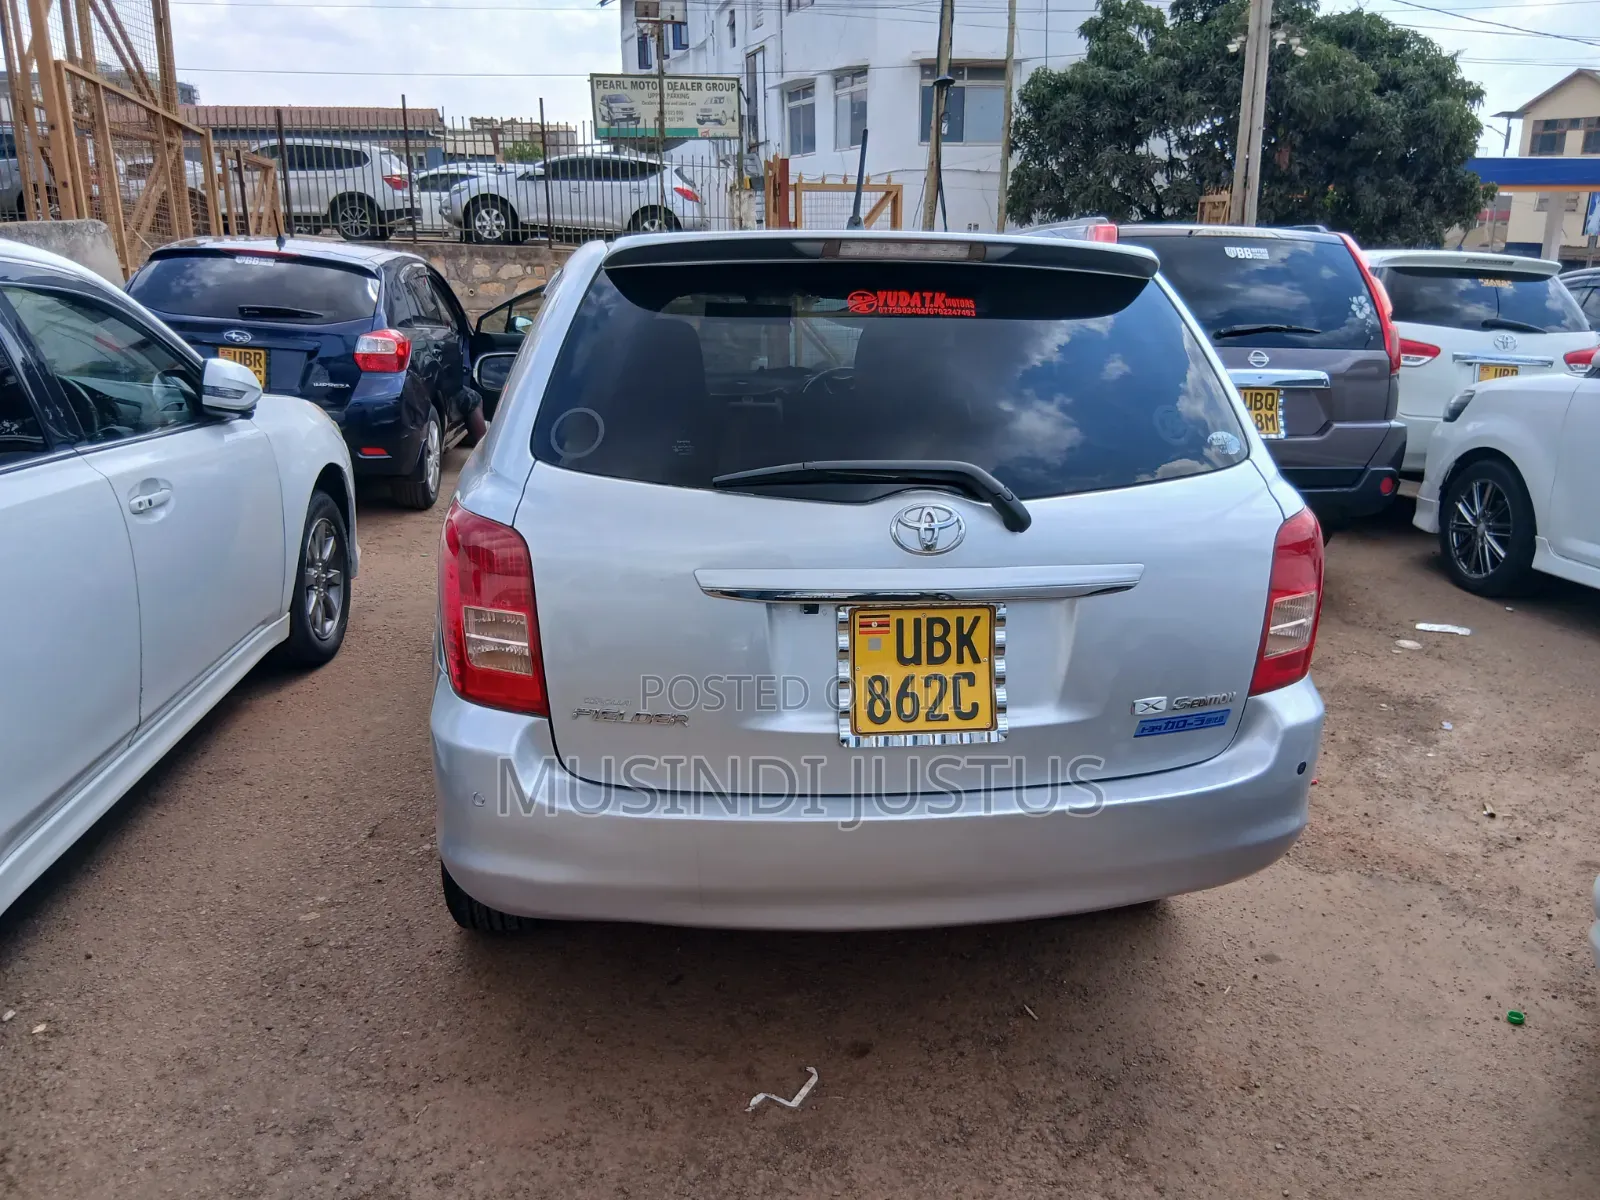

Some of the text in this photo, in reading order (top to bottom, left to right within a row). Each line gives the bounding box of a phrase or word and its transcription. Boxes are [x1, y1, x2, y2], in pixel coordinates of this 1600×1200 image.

[595, 79, 736, 92] PEARL MOTO DEALER GROUP
[876, 290, 919, 307] YUDA
[945, 298, 976, 309] MOTORS
[1243, 392, 1275, 412] UBQ
[896, 615, 982, 666] UBK
[866, 671, 980, 725] 862C
[571, 706, 691, 729] FIELDER
